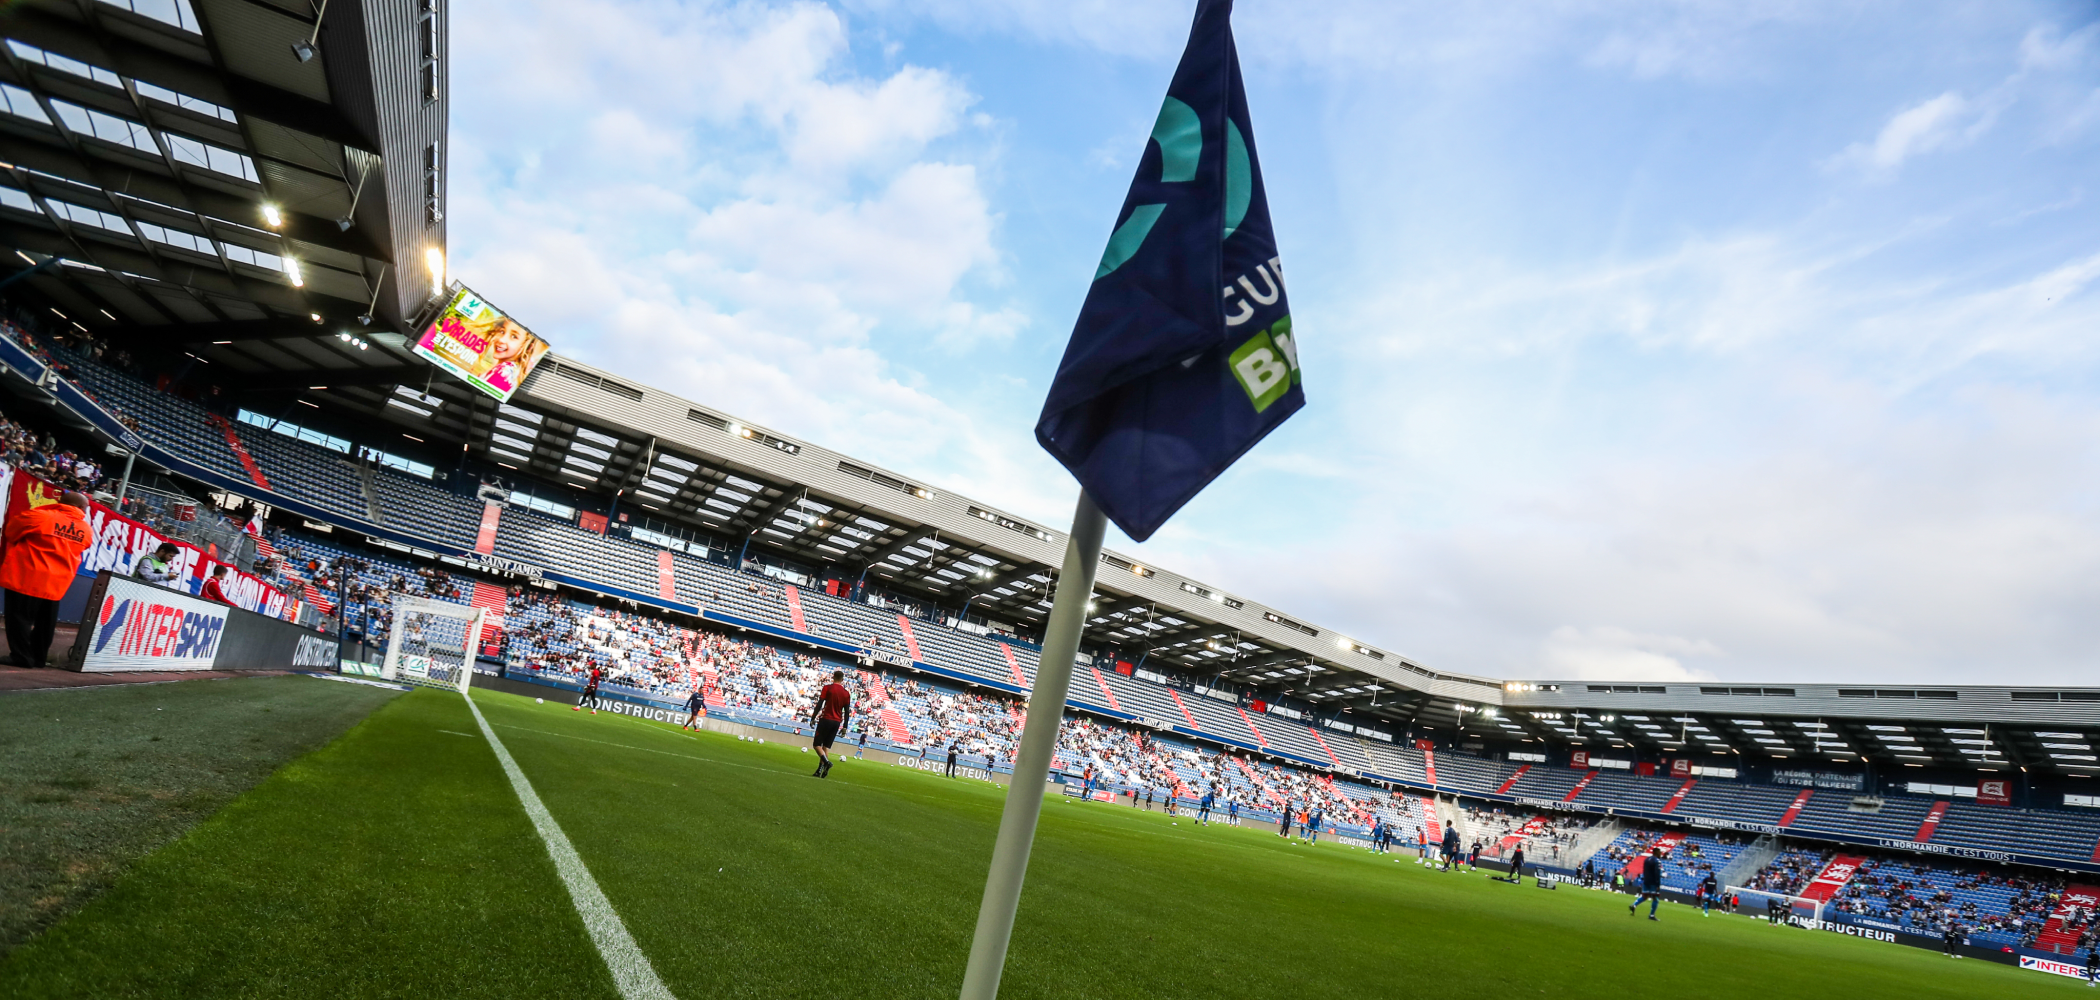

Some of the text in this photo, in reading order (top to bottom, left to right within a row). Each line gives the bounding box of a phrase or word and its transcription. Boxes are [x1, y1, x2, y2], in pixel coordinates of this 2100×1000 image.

[442, 316, 488, 354] VIRADES
[480, 555, 543, 578] SAINT JAMES
[119, 600, 224, 659] INTERSPORT
[870, 650, 913, 667] SAINT JAMES
[1814, 772, 1863, 783] PARTENAIRE
[1760, 826, 1780, 834] VOUS
[1339, 836, 1387, 851] CONSTRUCTE
[1893, 840, 1952, 855] NORMANDIE,
[1954, 847, 1980, 857] C'EST
[1983, 851, 2010, 861] VOUS
[1788, 914, 1896, 943] ONSTRUCTEUR
[1905, 926, 1924, 935] C'EST
[1924, 930, 1943, 939] VOUS
[2037, 960, 2100, 980] INTERS
